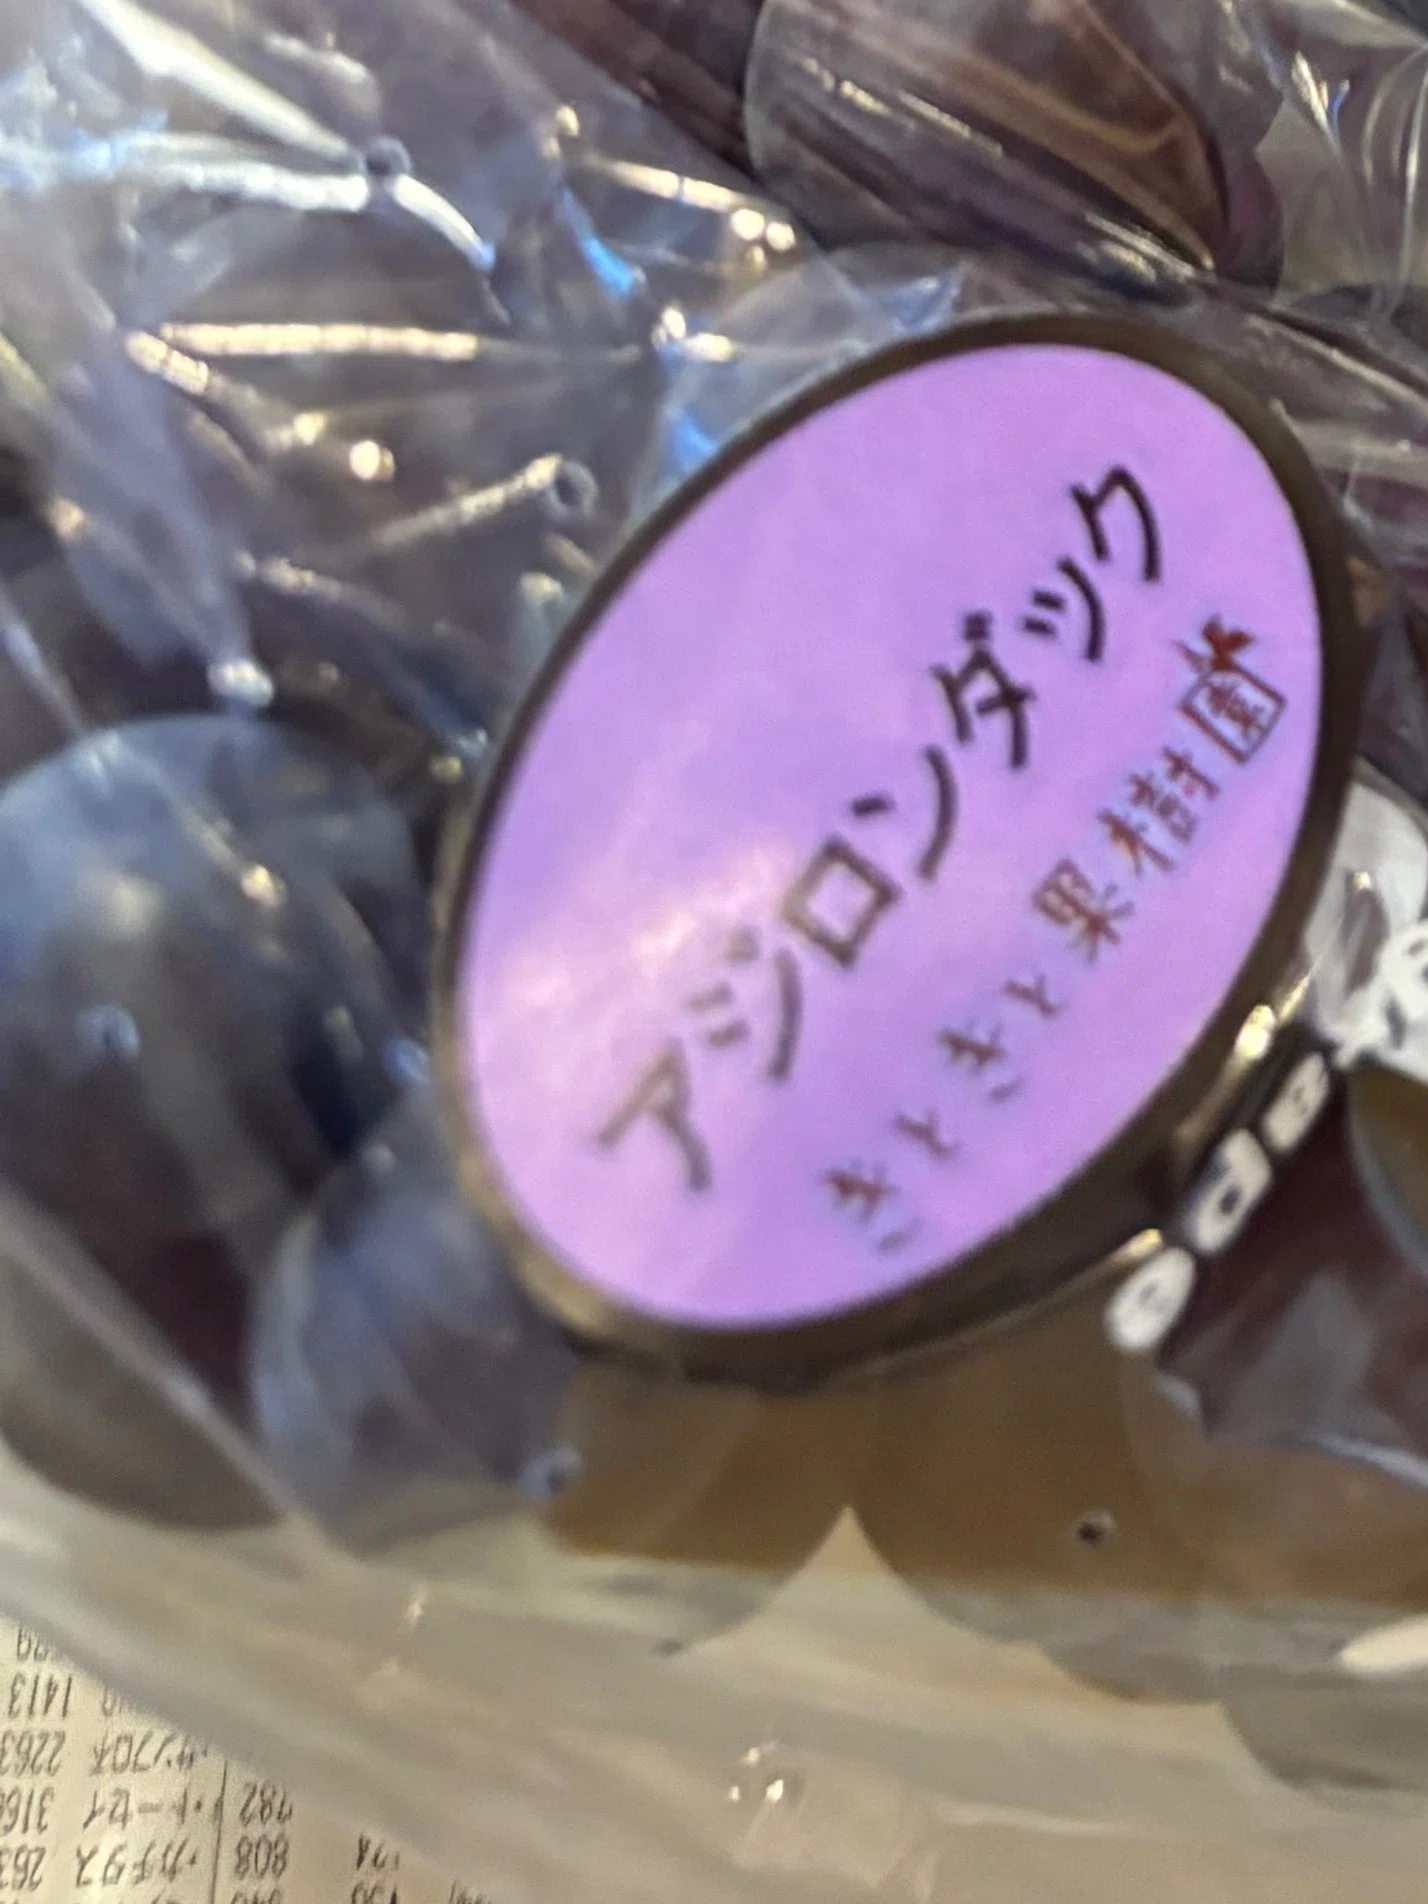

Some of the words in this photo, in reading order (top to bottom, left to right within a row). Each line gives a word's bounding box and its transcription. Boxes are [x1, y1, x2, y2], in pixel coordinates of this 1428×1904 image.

[593, 462, 1163, 1196] アジロンダック
[822, 612, 1290, 1254] きときと果樹園
